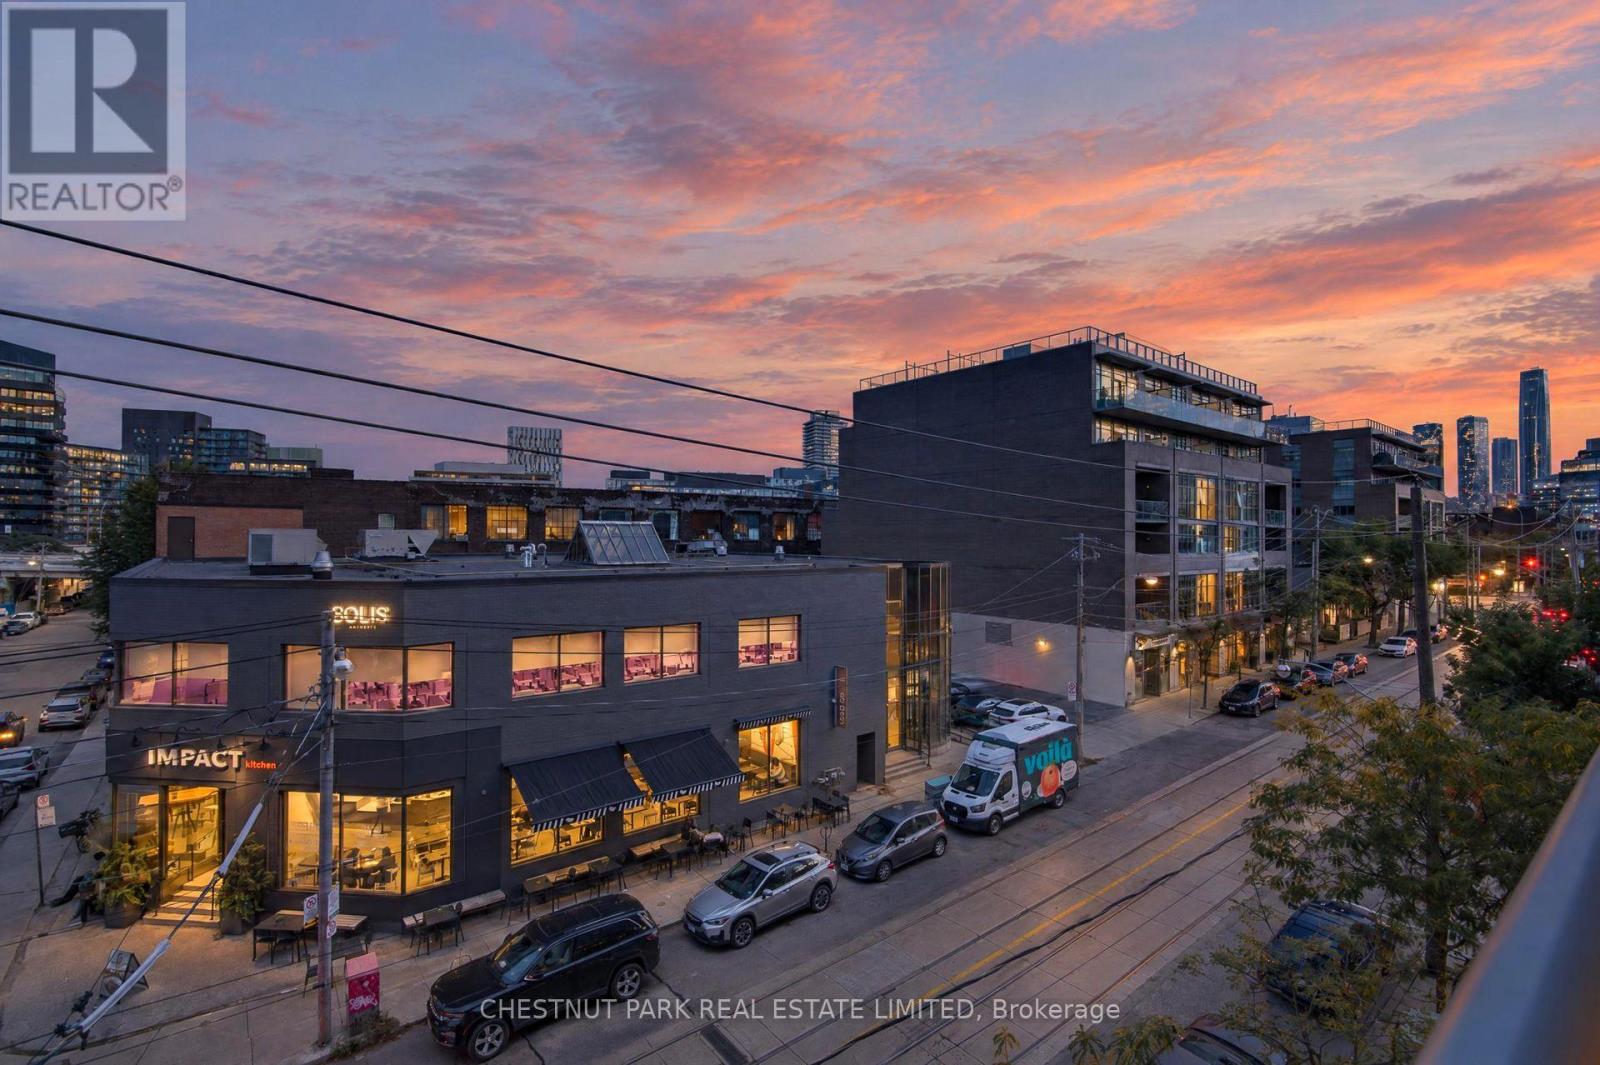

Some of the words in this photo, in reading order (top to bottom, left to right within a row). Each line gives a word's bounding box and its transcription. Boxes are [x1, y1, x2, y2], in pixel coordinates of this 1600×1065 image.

[332, 606, 388, 624] SOLIS
[148, 749, 244, 769] IMPACT
[245, 760, 277, 770] kitchen
